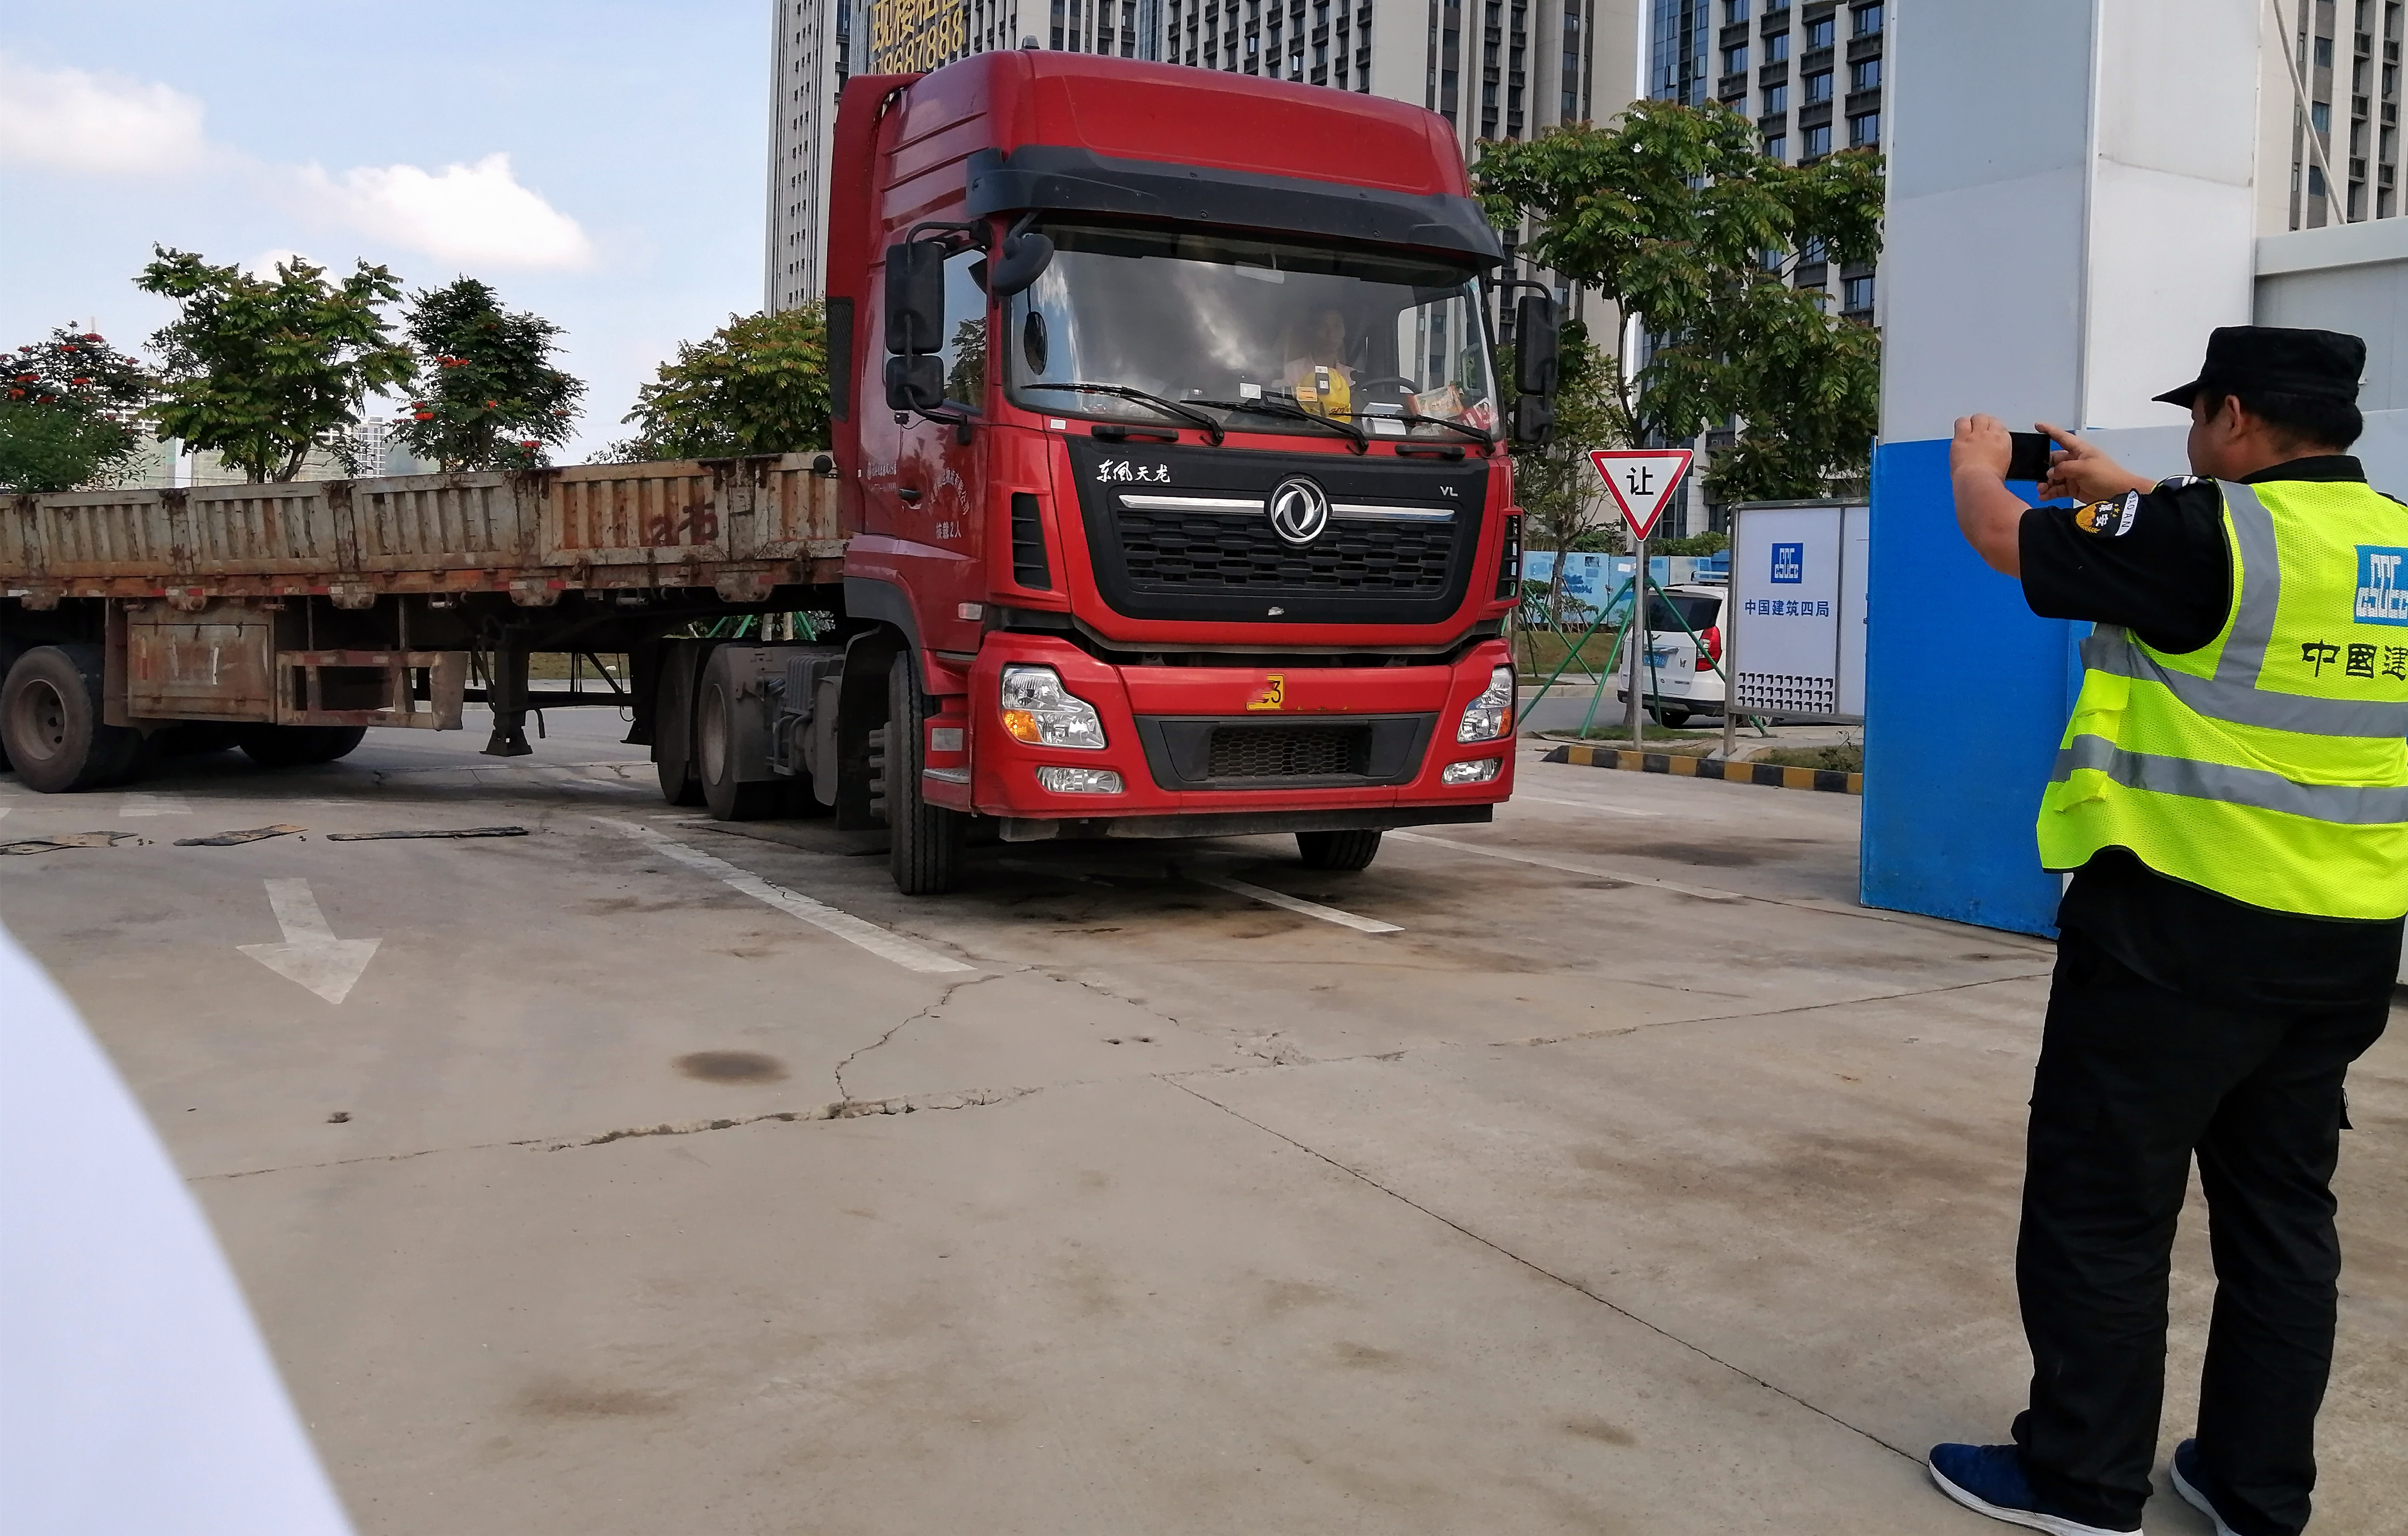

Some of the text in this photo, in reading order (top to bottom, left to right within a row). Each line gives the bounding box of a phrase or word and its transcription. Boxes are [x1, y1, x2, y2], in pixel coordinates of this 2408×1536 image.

[1626, 466, 1654, 495] 让
[1439, 486, 1458, 497] VL
[1745, 599, 1829, 617] 中国建筑四局
